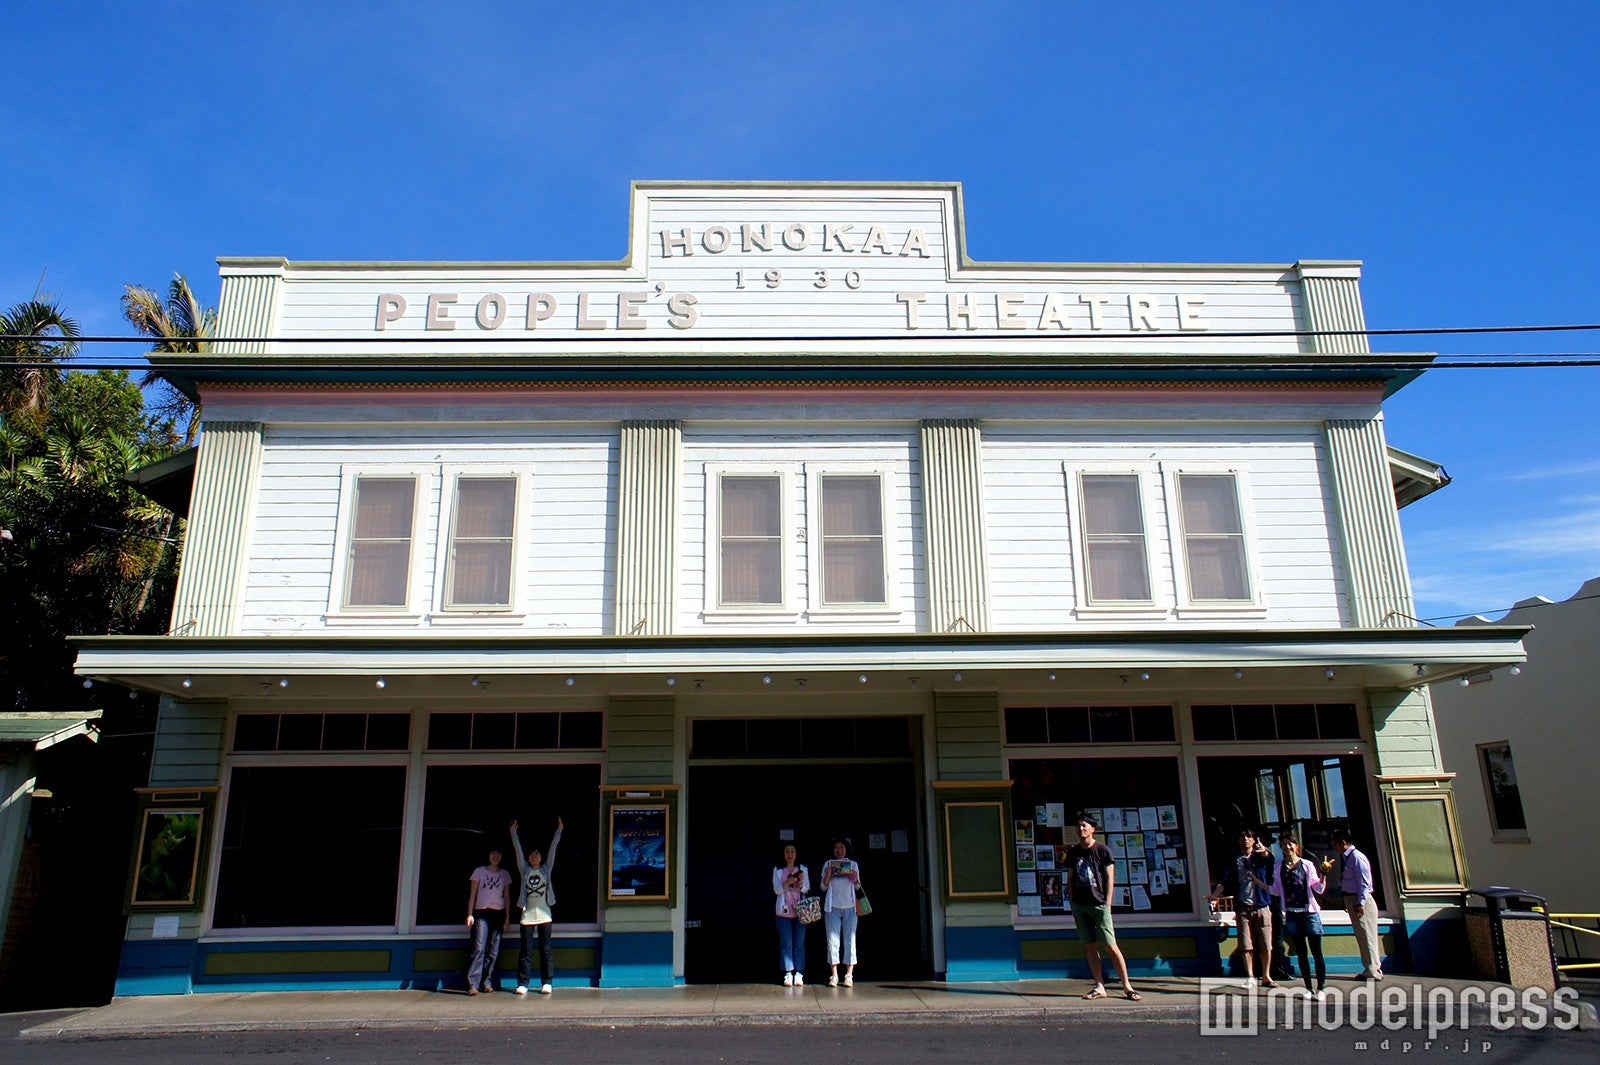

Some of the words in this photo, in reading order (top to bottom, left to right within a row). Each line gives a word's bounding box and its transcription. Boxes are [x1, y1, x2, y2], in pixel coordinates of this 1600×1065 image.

[660, 221, 932, 258] HONOKAA
[736, 267, 864, 290] 1930
[375, 281, 699, 331] PEOPLE'S
[896, 292, 1210, 332] THEATRE
